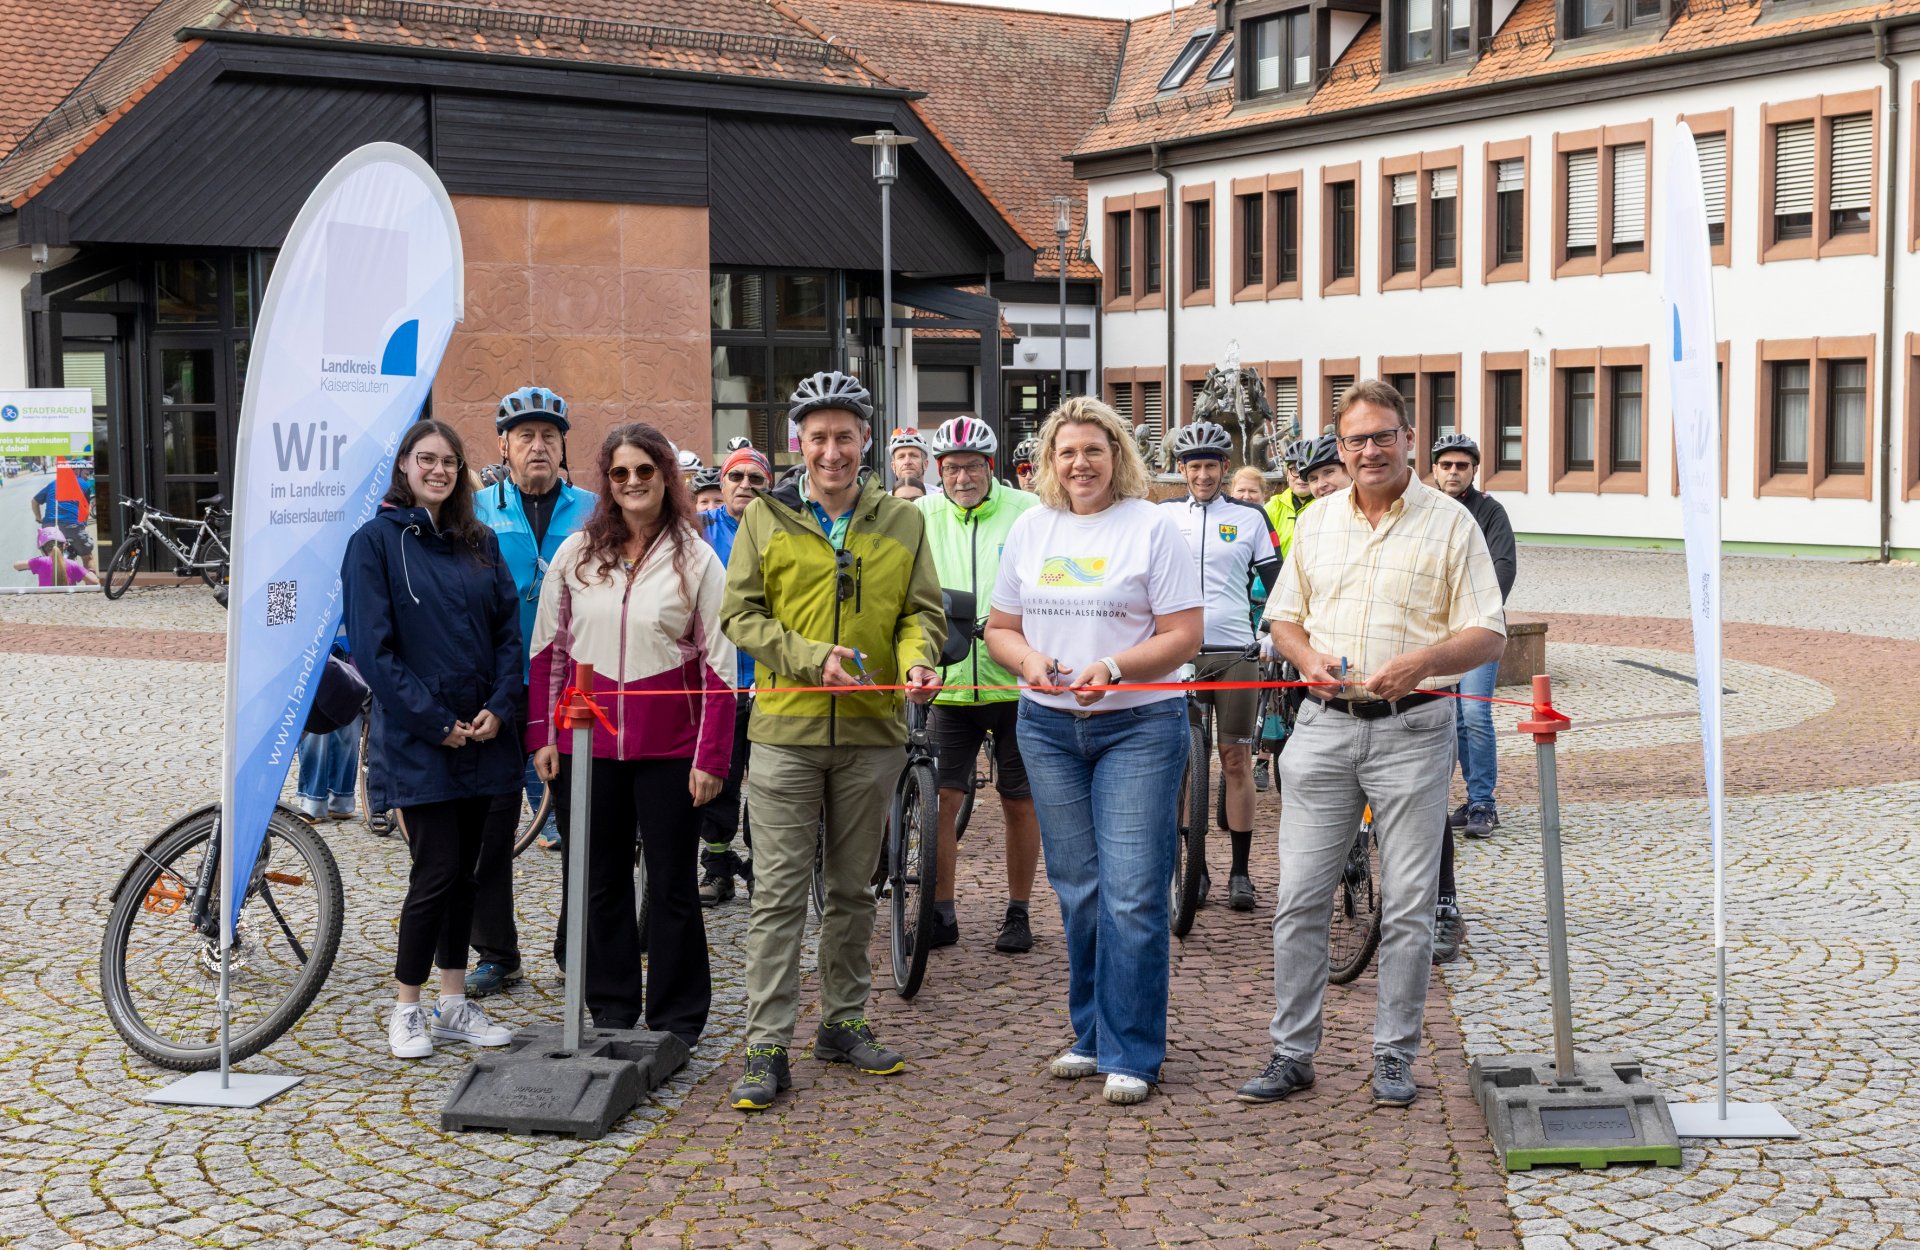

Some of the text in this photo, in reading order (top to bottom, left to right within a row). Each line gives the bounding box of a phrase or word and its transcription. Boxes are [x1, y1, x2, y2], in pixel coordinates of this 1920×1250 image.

[321, 358, 377, 375] Landkreis
[320, 376, 389, 394] Kaiserslautern
[22, 406, 87, 414] STADTRADELN
[5, 445, 30, 453] dabei!
[15, 436, 69, 445] Kaiserslautern
[272, 420, 348, 472] Wir
[271, 481, 346, 499] im Landkreis
[269, 508, 345, 526] Kaiserslautern
[1025, 608, 1127, 618] ENKENBACH-ALSENBORN
